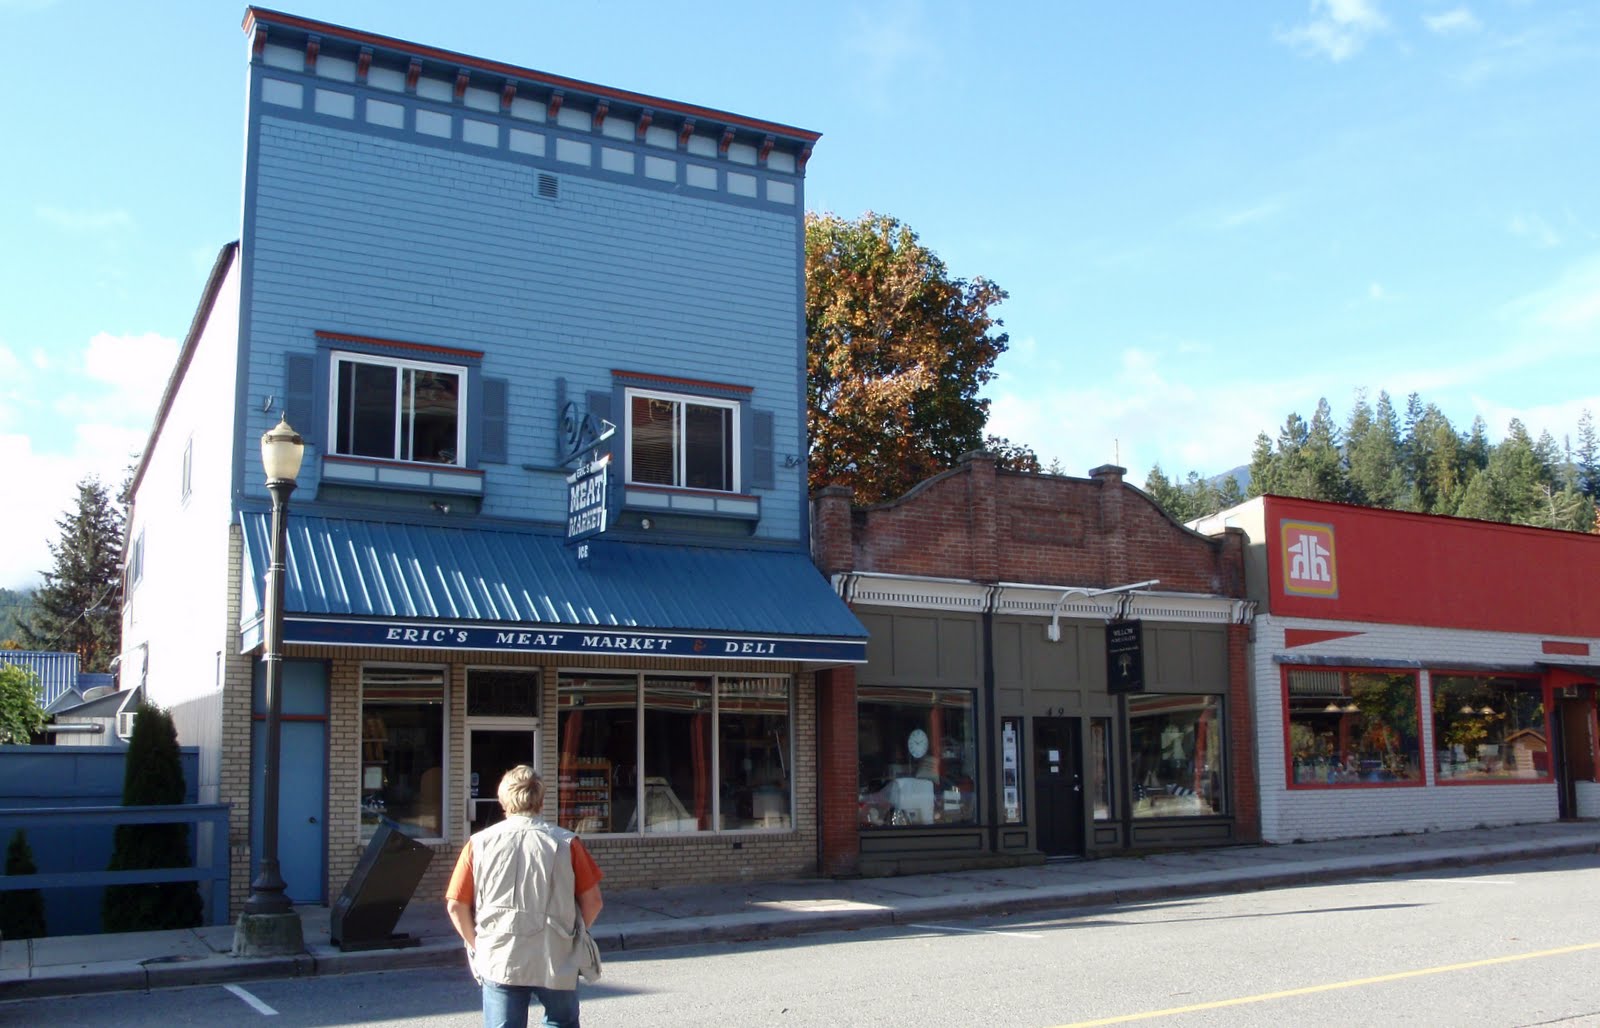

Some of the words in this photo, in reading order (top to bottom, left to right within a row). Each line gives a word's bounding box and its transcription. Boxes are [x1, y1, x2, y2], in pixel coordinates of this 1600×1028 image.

[570, 474, 604, 513] MEAT
[568, 506, 602, 538] MARKET
[578, 545, 589, 559] ICE
[386, 627, 469, 643] ERIC'S
[497, 631, 564, 647] MEAT
[581, 635, 673, 651] MARKET
[724, 641, 776, 654] DELI
